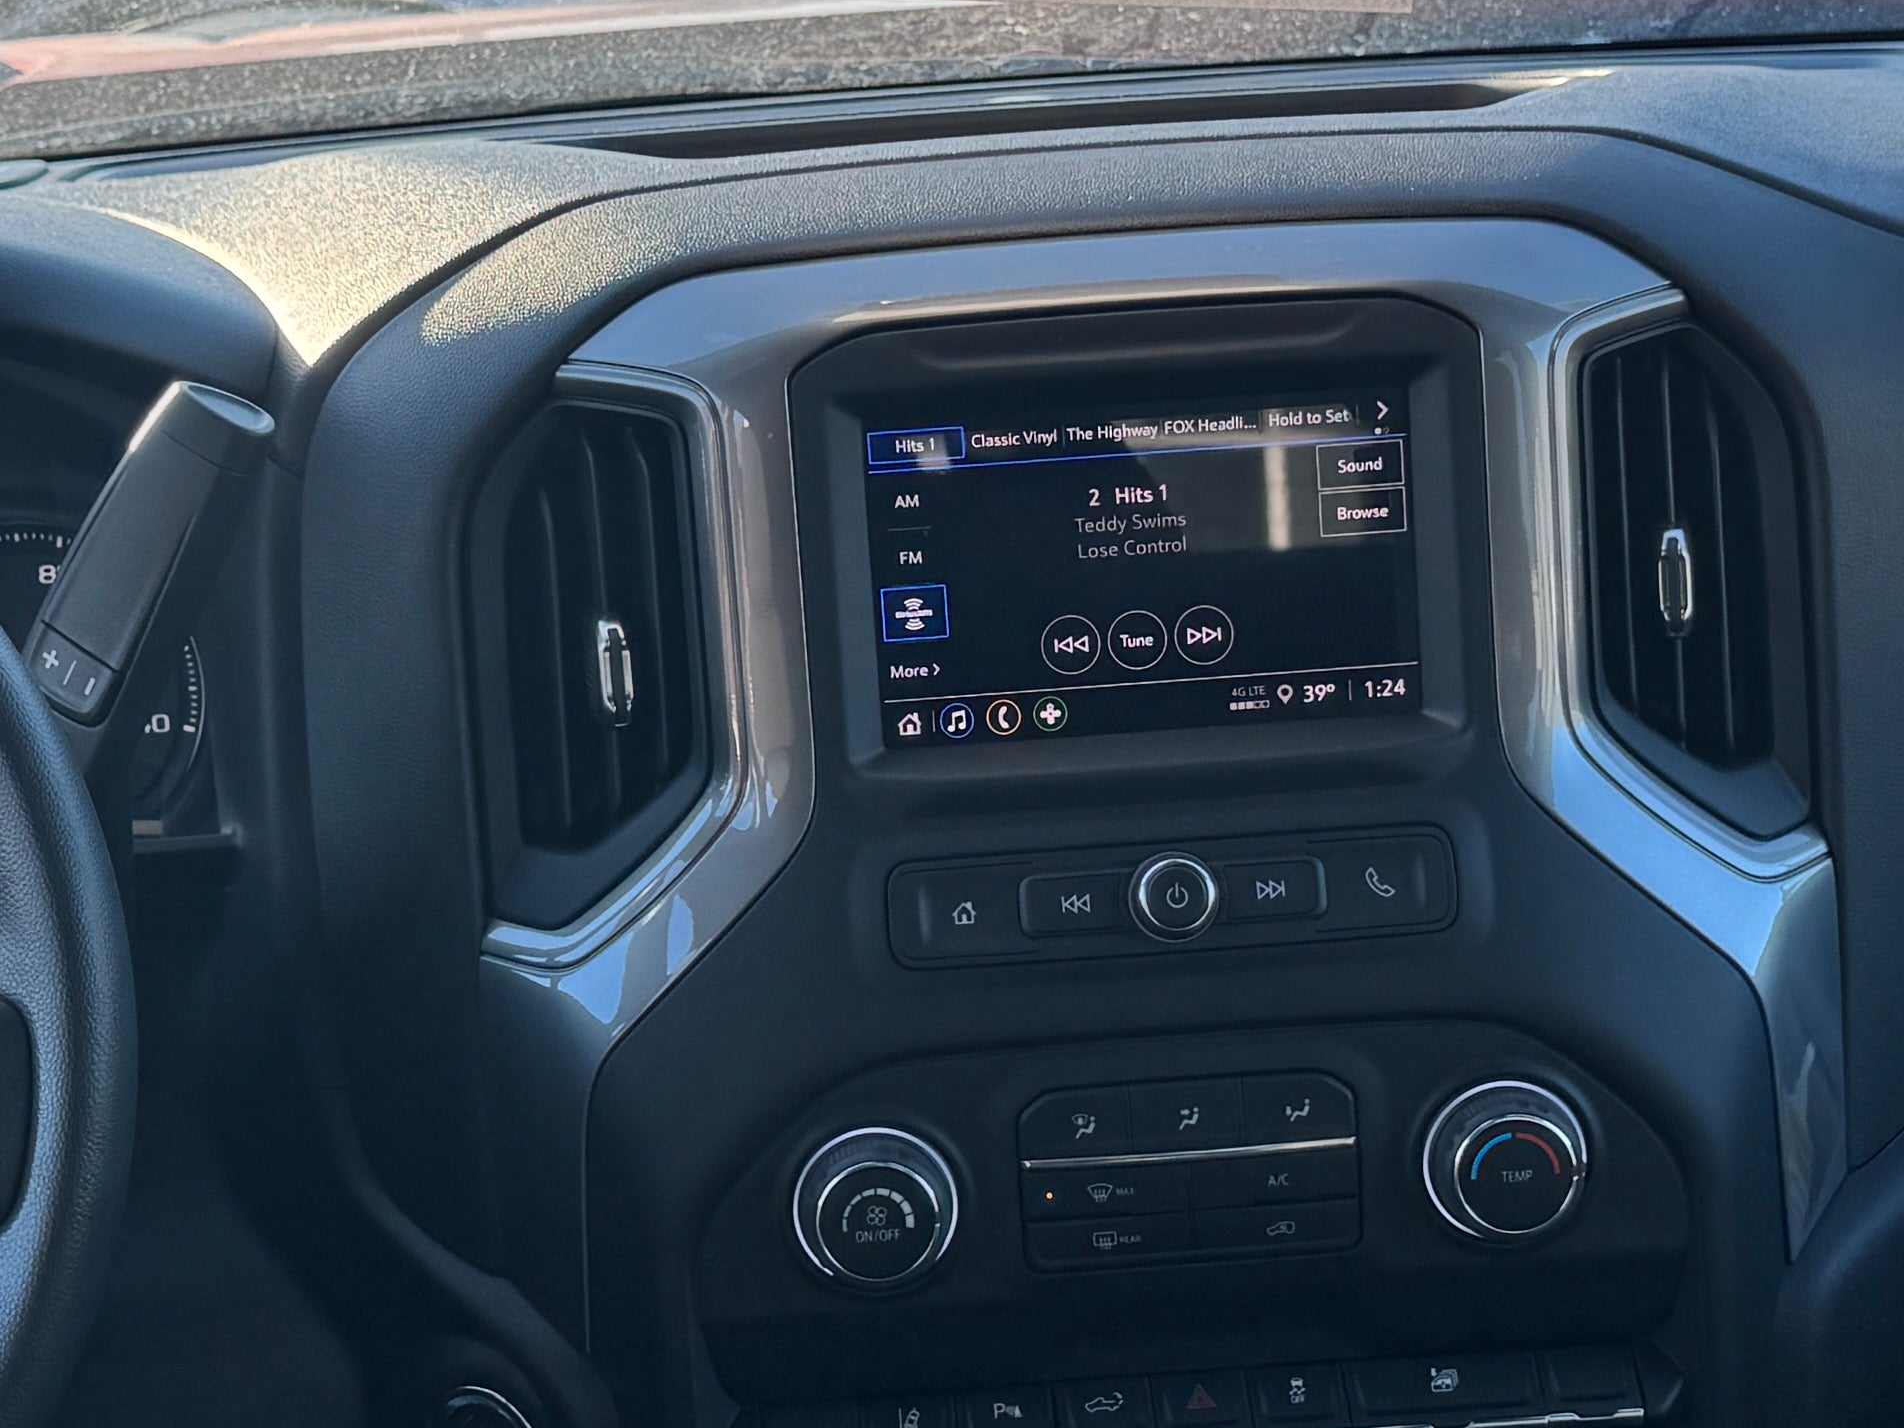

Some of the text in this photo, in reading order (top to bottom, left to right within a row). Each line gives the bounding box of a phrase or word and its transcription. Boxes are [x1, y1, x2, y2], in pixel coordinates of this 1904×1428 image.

[1269, 409, 1349, 427] Hold to Set
[1066, 423, 1158, 442] The Highway
[1164, 420, 1195, 435] FOX
[895, 437, 936, 454] Hits 1
[971, 429, 1058, 449] Classic Vinyl
[1337, 457, 1384, 474] Sound
[894, 494, 920, 509] AM
[1087, 484, 1169, 506] 2 Hits 1
[1337, 506, 1389, 521] Browse
[1074, 512, 1187, 535] Teddy Swims
[1077, 535, 1188, 559] Lose Control
[899, 551, 923, 565] FM
[1120, 634, 1155, 649] Tune
[890, 665, 929, 679] More
[1231, 685, 1267, 698] 4G LTE
[1364, 678, 1407, 699] 1:24
[1267, 1172, 1290, 1187] A/C
[1501, 1169, 1533, 1183] TEMP
[855, 1227, 902, 1244] ON/OFF
